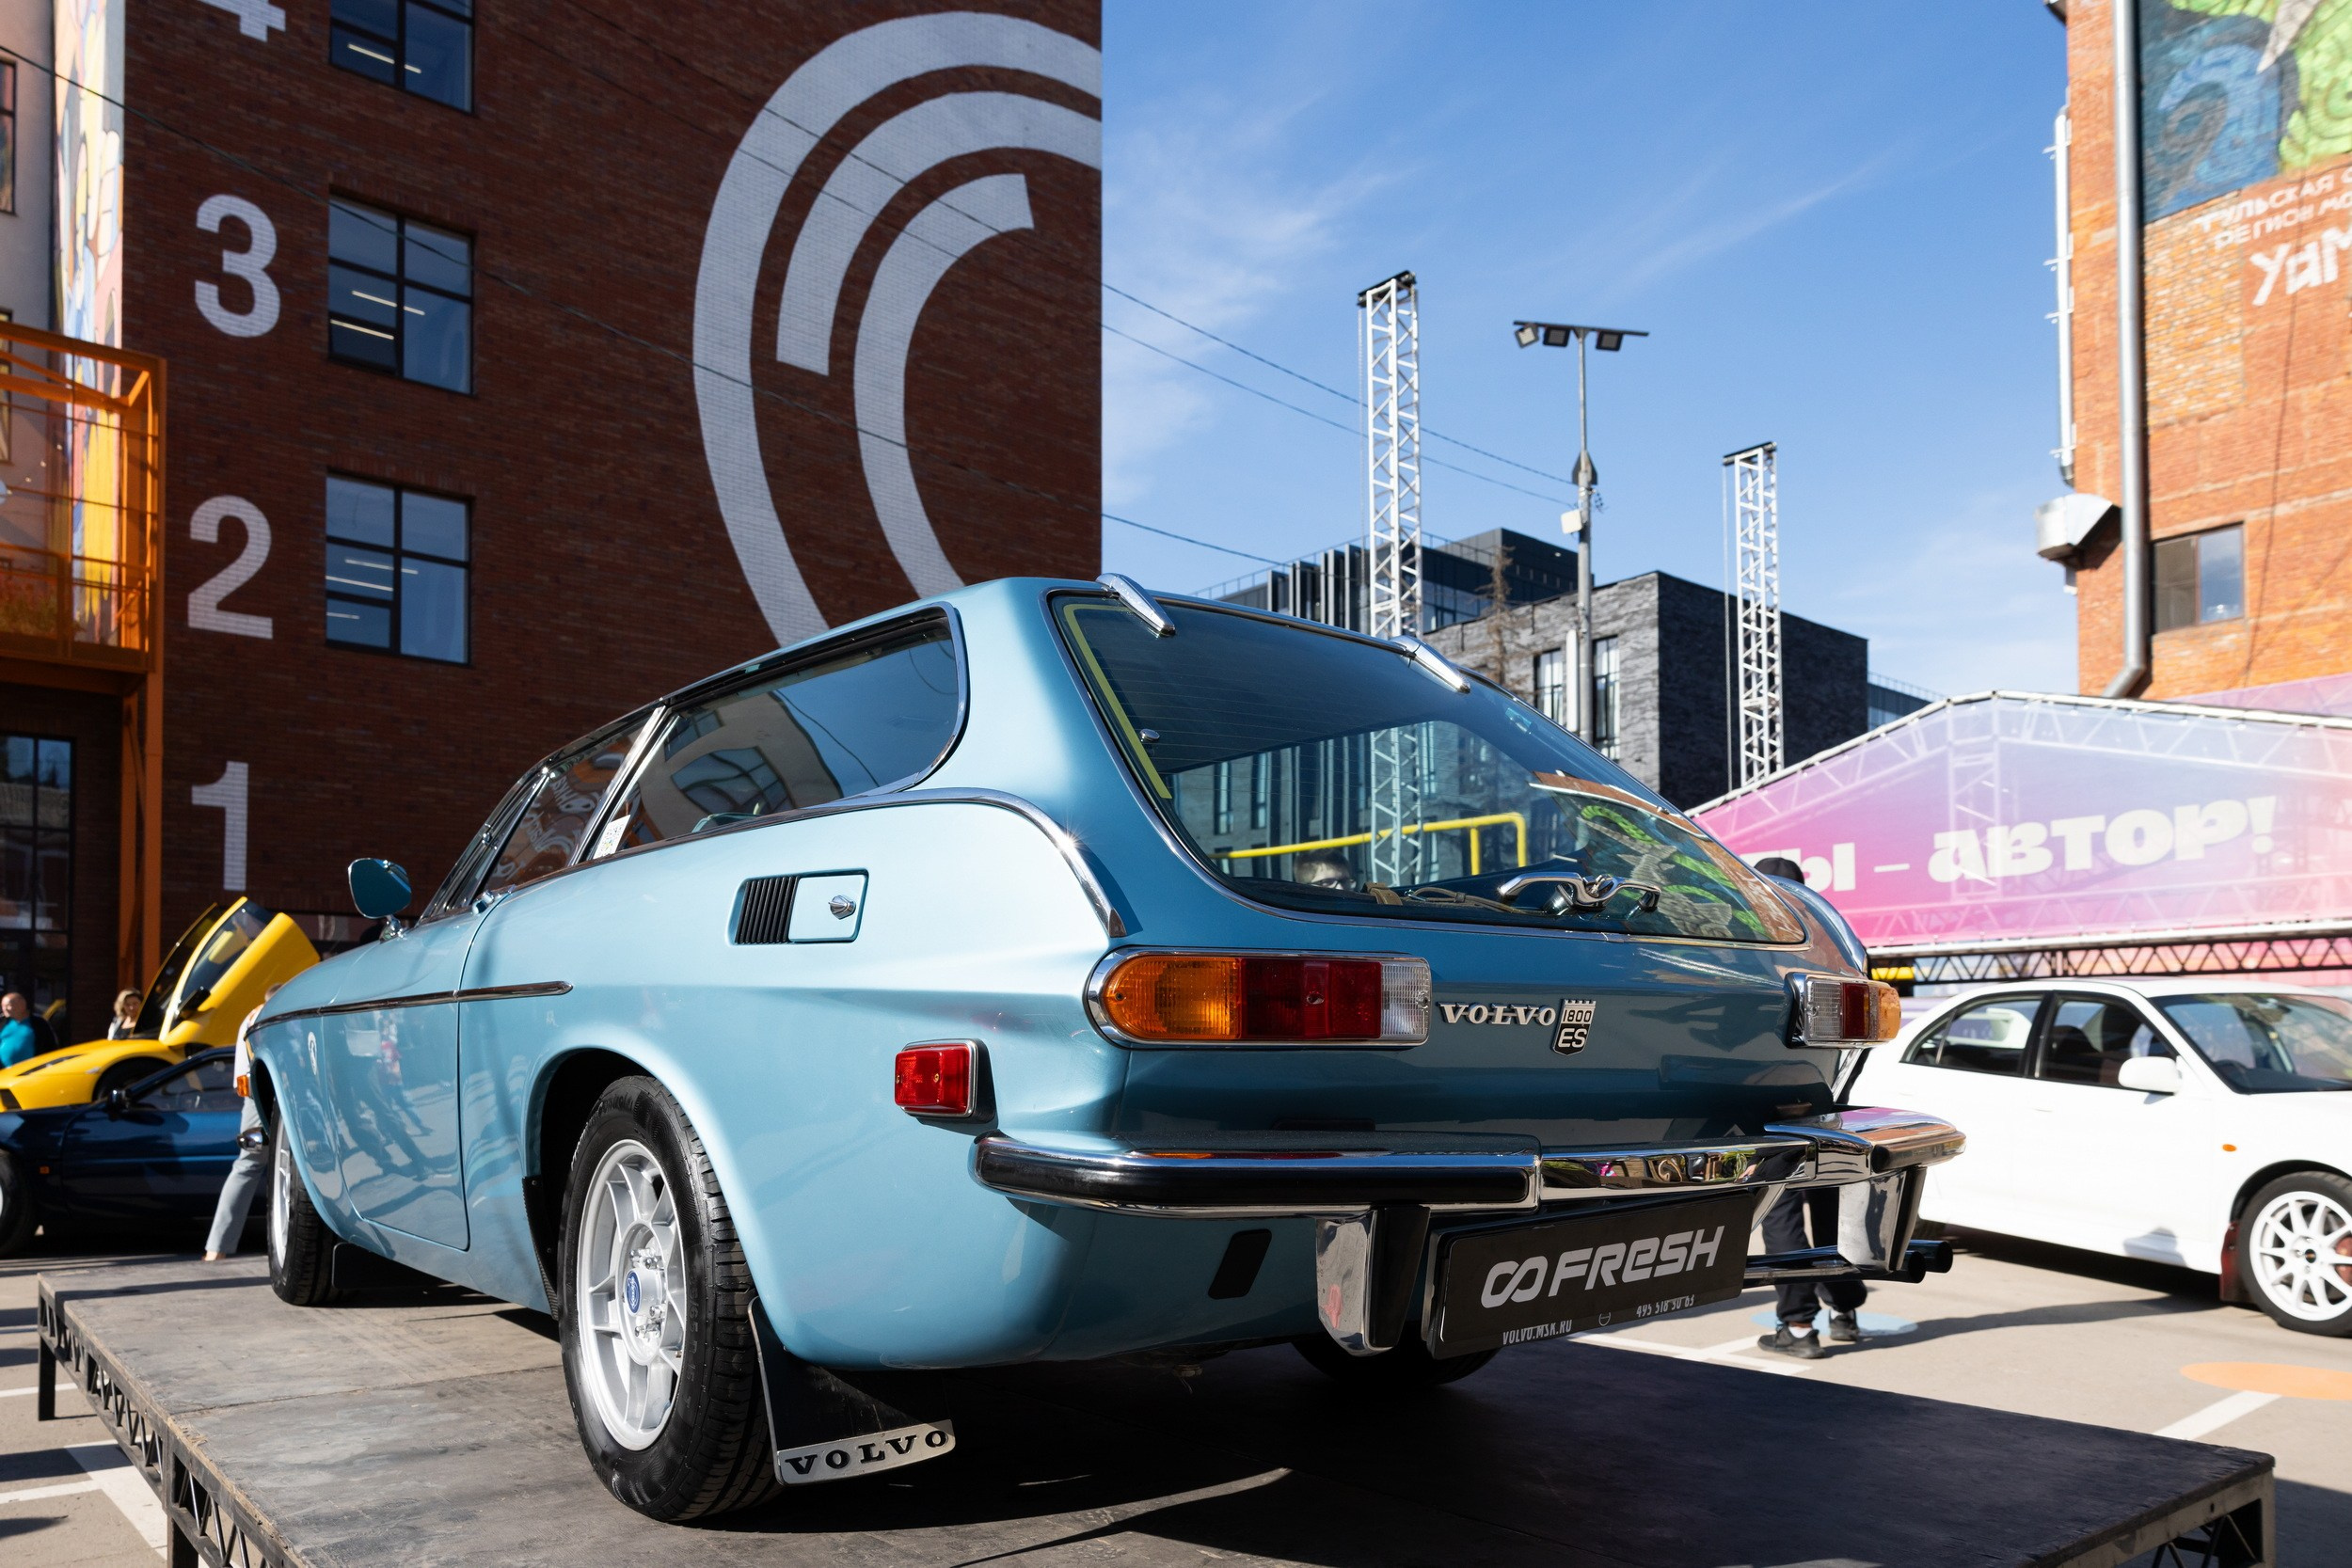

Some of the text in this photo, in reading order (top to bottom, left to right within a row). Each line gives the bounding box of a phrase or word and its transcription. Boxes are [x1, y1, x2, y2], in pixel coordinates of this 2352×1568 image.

[195, 194, 281, 339] 3
[187, 495, 274, 641] 2
[191, 760, 248, 892] 1
[1437, 1001, 1557, 1026] VOLVO
[1563, 1008, 1592, 1023] 1800
[1557, 1027, 1588, 1048] ES
[1636, 1304, 1652, 1318] 495
[785, 1430, 949, 1475] VOLVO
